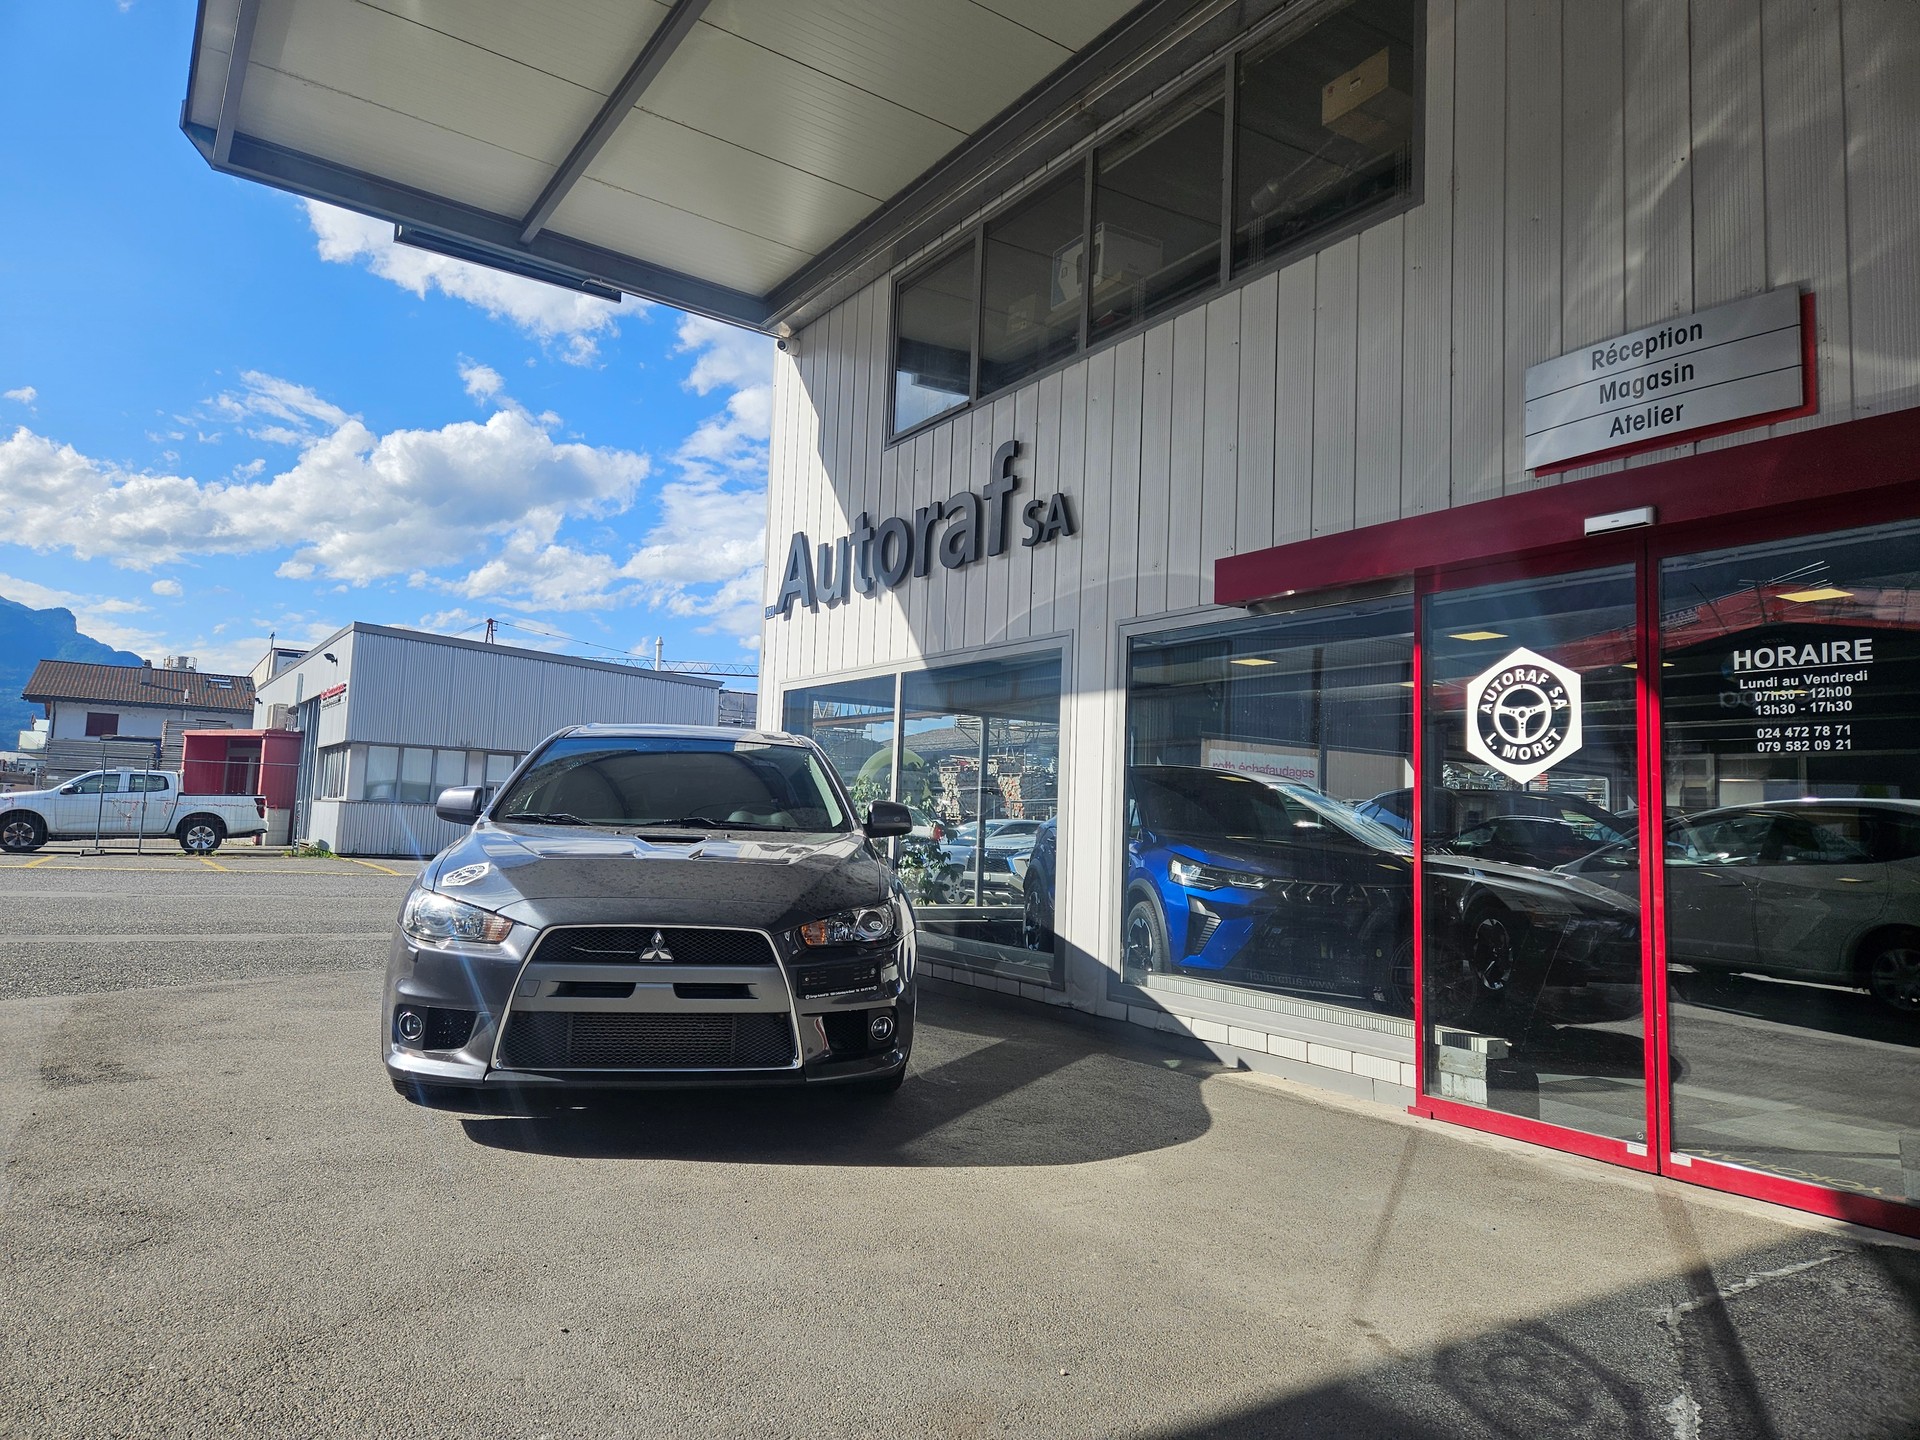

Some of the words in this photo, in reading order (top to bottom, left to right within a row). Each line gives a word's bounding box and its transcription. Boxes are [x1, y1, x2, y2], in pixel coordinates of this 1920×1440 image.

[1592, 323, 1703, 371] Réception
[1599, 362, 1695, 404] Magasin
[1609, 403, 1685, 438] Atelier
[775, 440, 1020, 615] Autoraf
[1021, 492, 1075, 547] SA
[1733, 638, 1874, 671] HORAIRE
[1480, 668, 1550, 715] AUTORAF
[1548, 686, 1568, 711] SA
[1739, 676, 1778, 689] Lundi
[1782, 677, 1799, 687] au
[1803, 670, 1868, 685] Vendredi
[1754, 689, 1796, 702] 07h30
[1809, 685, 1852, 699] 12h00
[1755, 703, 1796, 715] 13h30
[1810, 700, 1853, 713] 17h30
[1502, 728, 1562, 761] MORET
[1756, 727, 1781, 739] 024
[1784, 726, 1810, 738] 472
[1813, 725, 1831, 737] 78
[1834, 724, 1851, 736] 71
[1757, 741, 1781, 752] 079
[1785, 740, 1810, 752] 582
[1814, 739, 1831, 751] 09
[1835, 738, 1852, 750] 21
